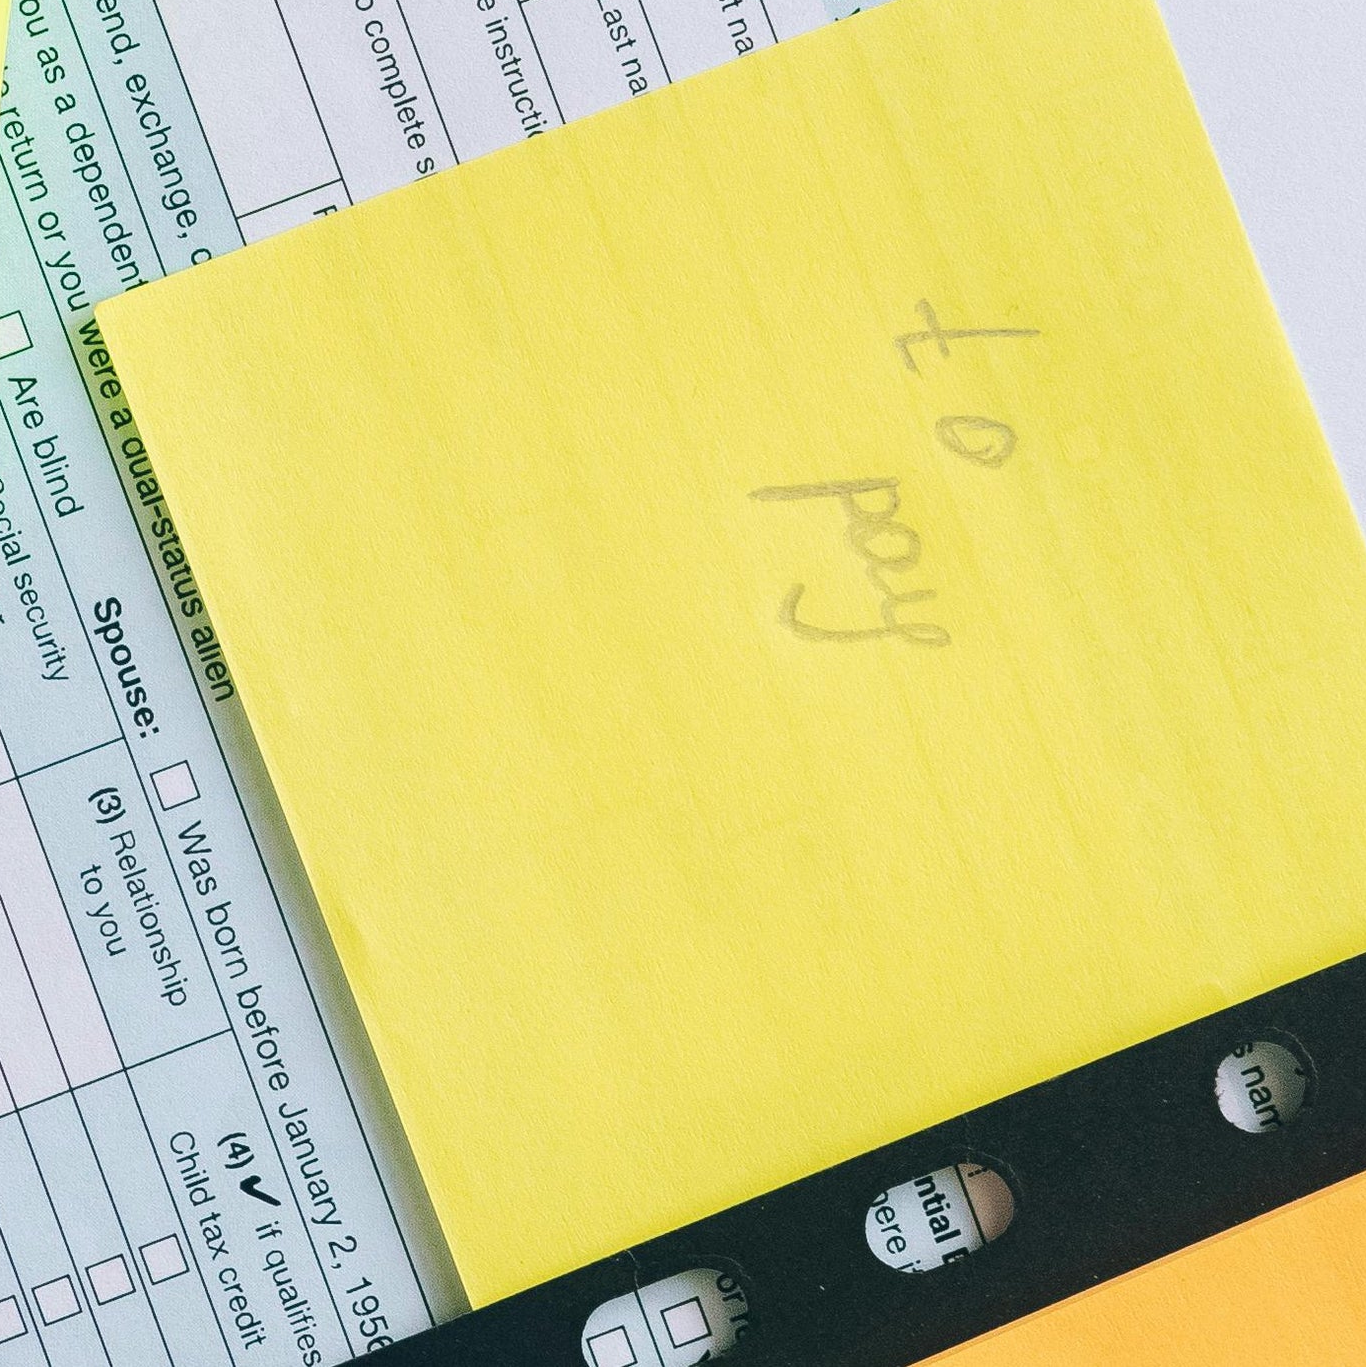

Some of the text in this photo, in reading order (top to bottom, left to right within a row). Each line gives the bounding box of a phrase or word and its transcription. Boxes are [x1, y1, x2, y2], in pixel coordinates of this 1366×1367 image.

[7, 376, 84, 518] Are blind
[892, 297, 1041, 468] to
[12, 572, 70, 680] security
[747, 477, 952, 649] pay
[92, 596, 159, 739] Spouse:
[79, 863, 126, 956] to you
[87, 786, 188, 1006] (3) Relationship
[177, 819, 357, 1269] Was born before January 2,
[169, 1130, 266, 1350] Child tax credit
[216, 1131, 322, 1364] (4) if qualifies
